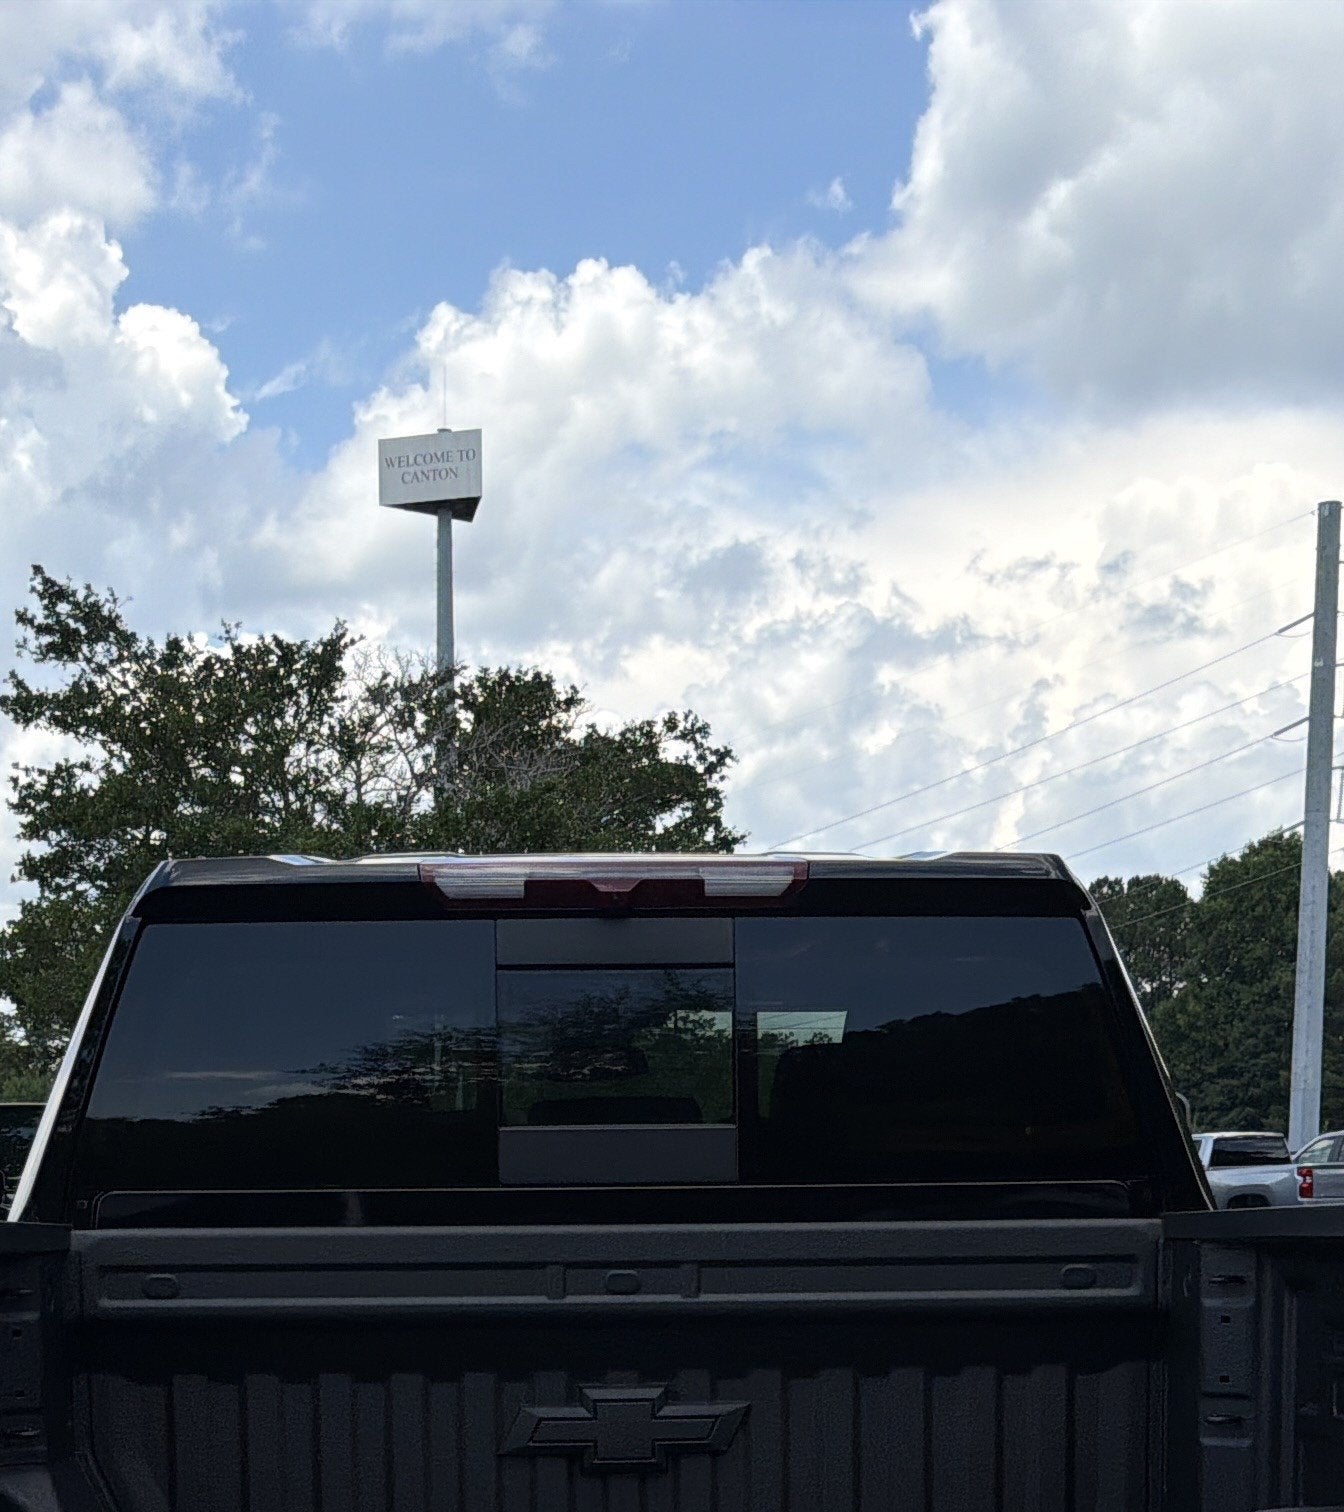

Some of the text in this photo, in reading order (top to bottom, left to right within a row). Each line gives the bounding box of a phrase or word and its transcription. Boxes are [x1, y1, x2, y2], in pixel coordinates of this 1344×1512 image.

[384, 448, 476, 470] WELCOME TO
[400, 467, 458, 485] CANTON
